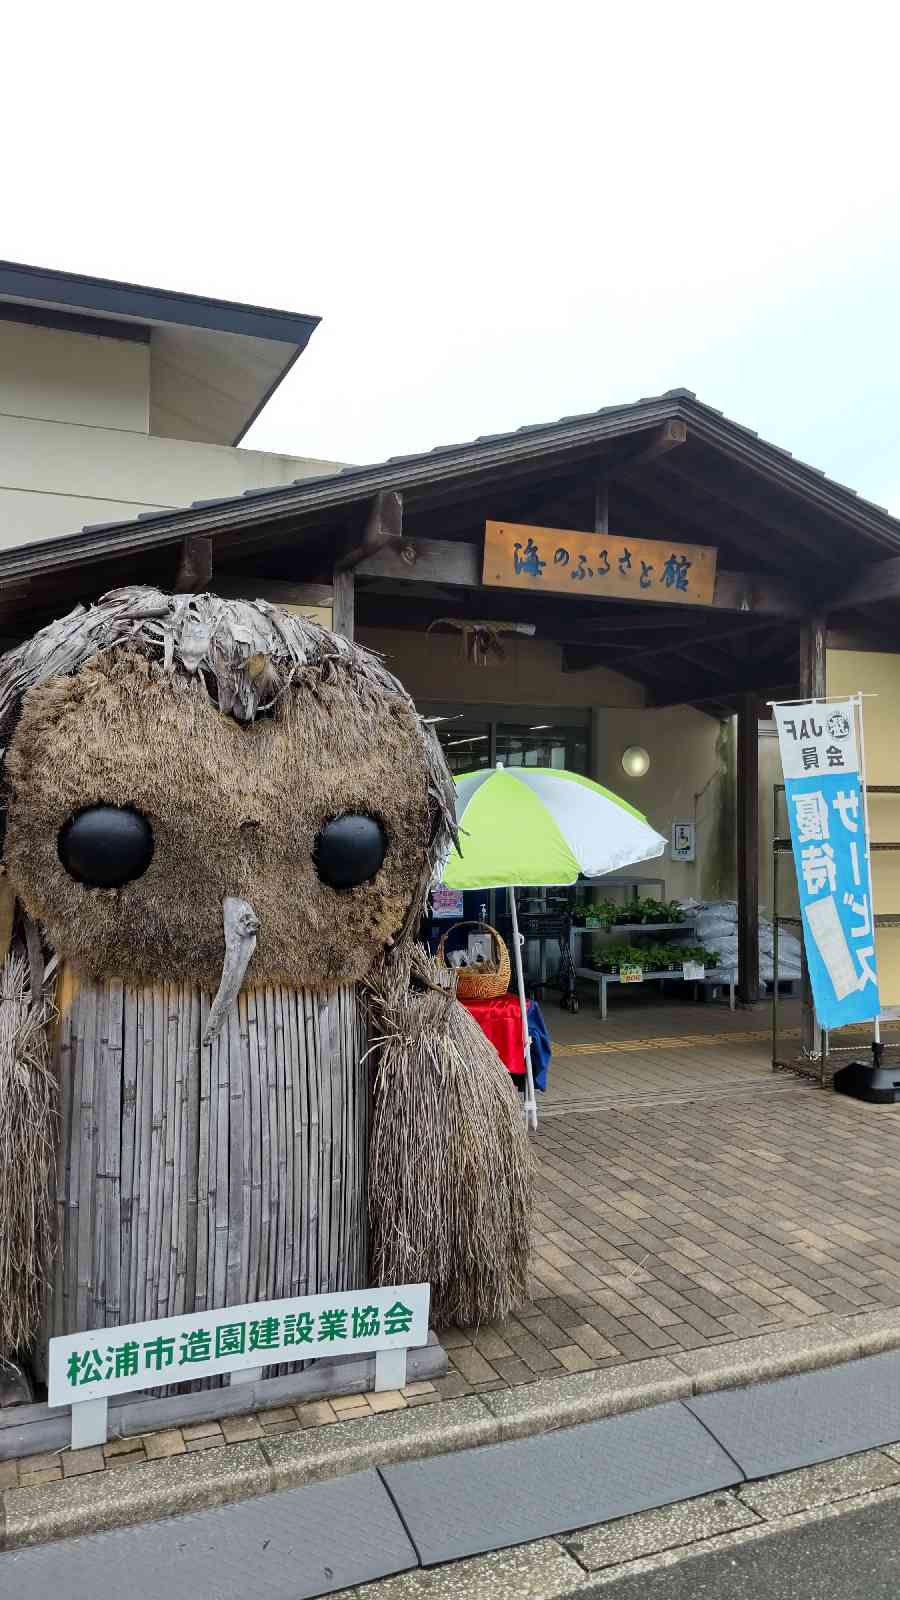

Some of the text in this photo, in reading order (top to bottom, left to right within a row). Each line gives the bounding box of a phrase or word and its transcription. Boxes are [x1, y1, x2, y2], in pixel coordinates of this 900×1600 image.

[514, 538, 691, 592] 海のふるさと館
[66, 1301, 414, 1386] 松浦市造園建設業協会
